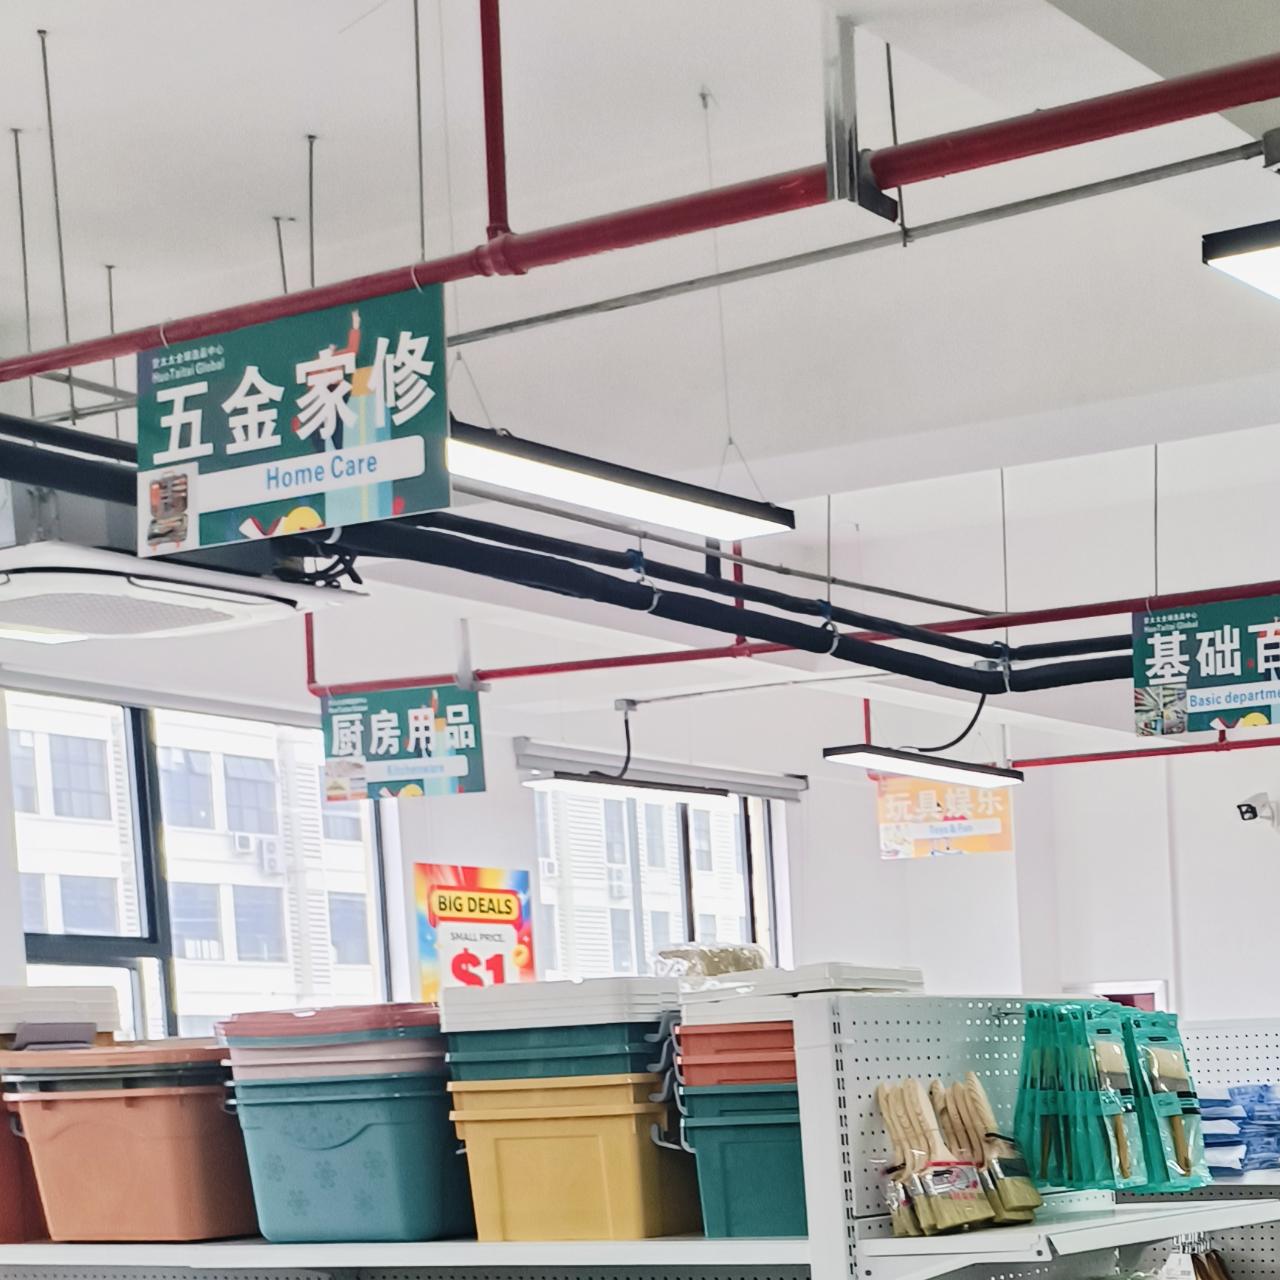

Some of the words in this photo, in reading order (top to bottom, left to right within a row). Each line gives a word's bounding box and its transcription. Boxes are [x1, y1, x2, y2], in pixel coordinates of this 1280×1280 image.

[153, 331, 436, 466] 五金家修
[266, 463, 325, 490] Home
[331, 453, 378, 478] Care
[1190, 692, 1221, 707] Basic
[331, 704, 475, 758] 厨房用品
[438, 896, 463, 912] BIG
[467, 897, 513, 915] DEALS
[450, 932, 477, 942] SMALL
[451, 948, 505, 987] $1
